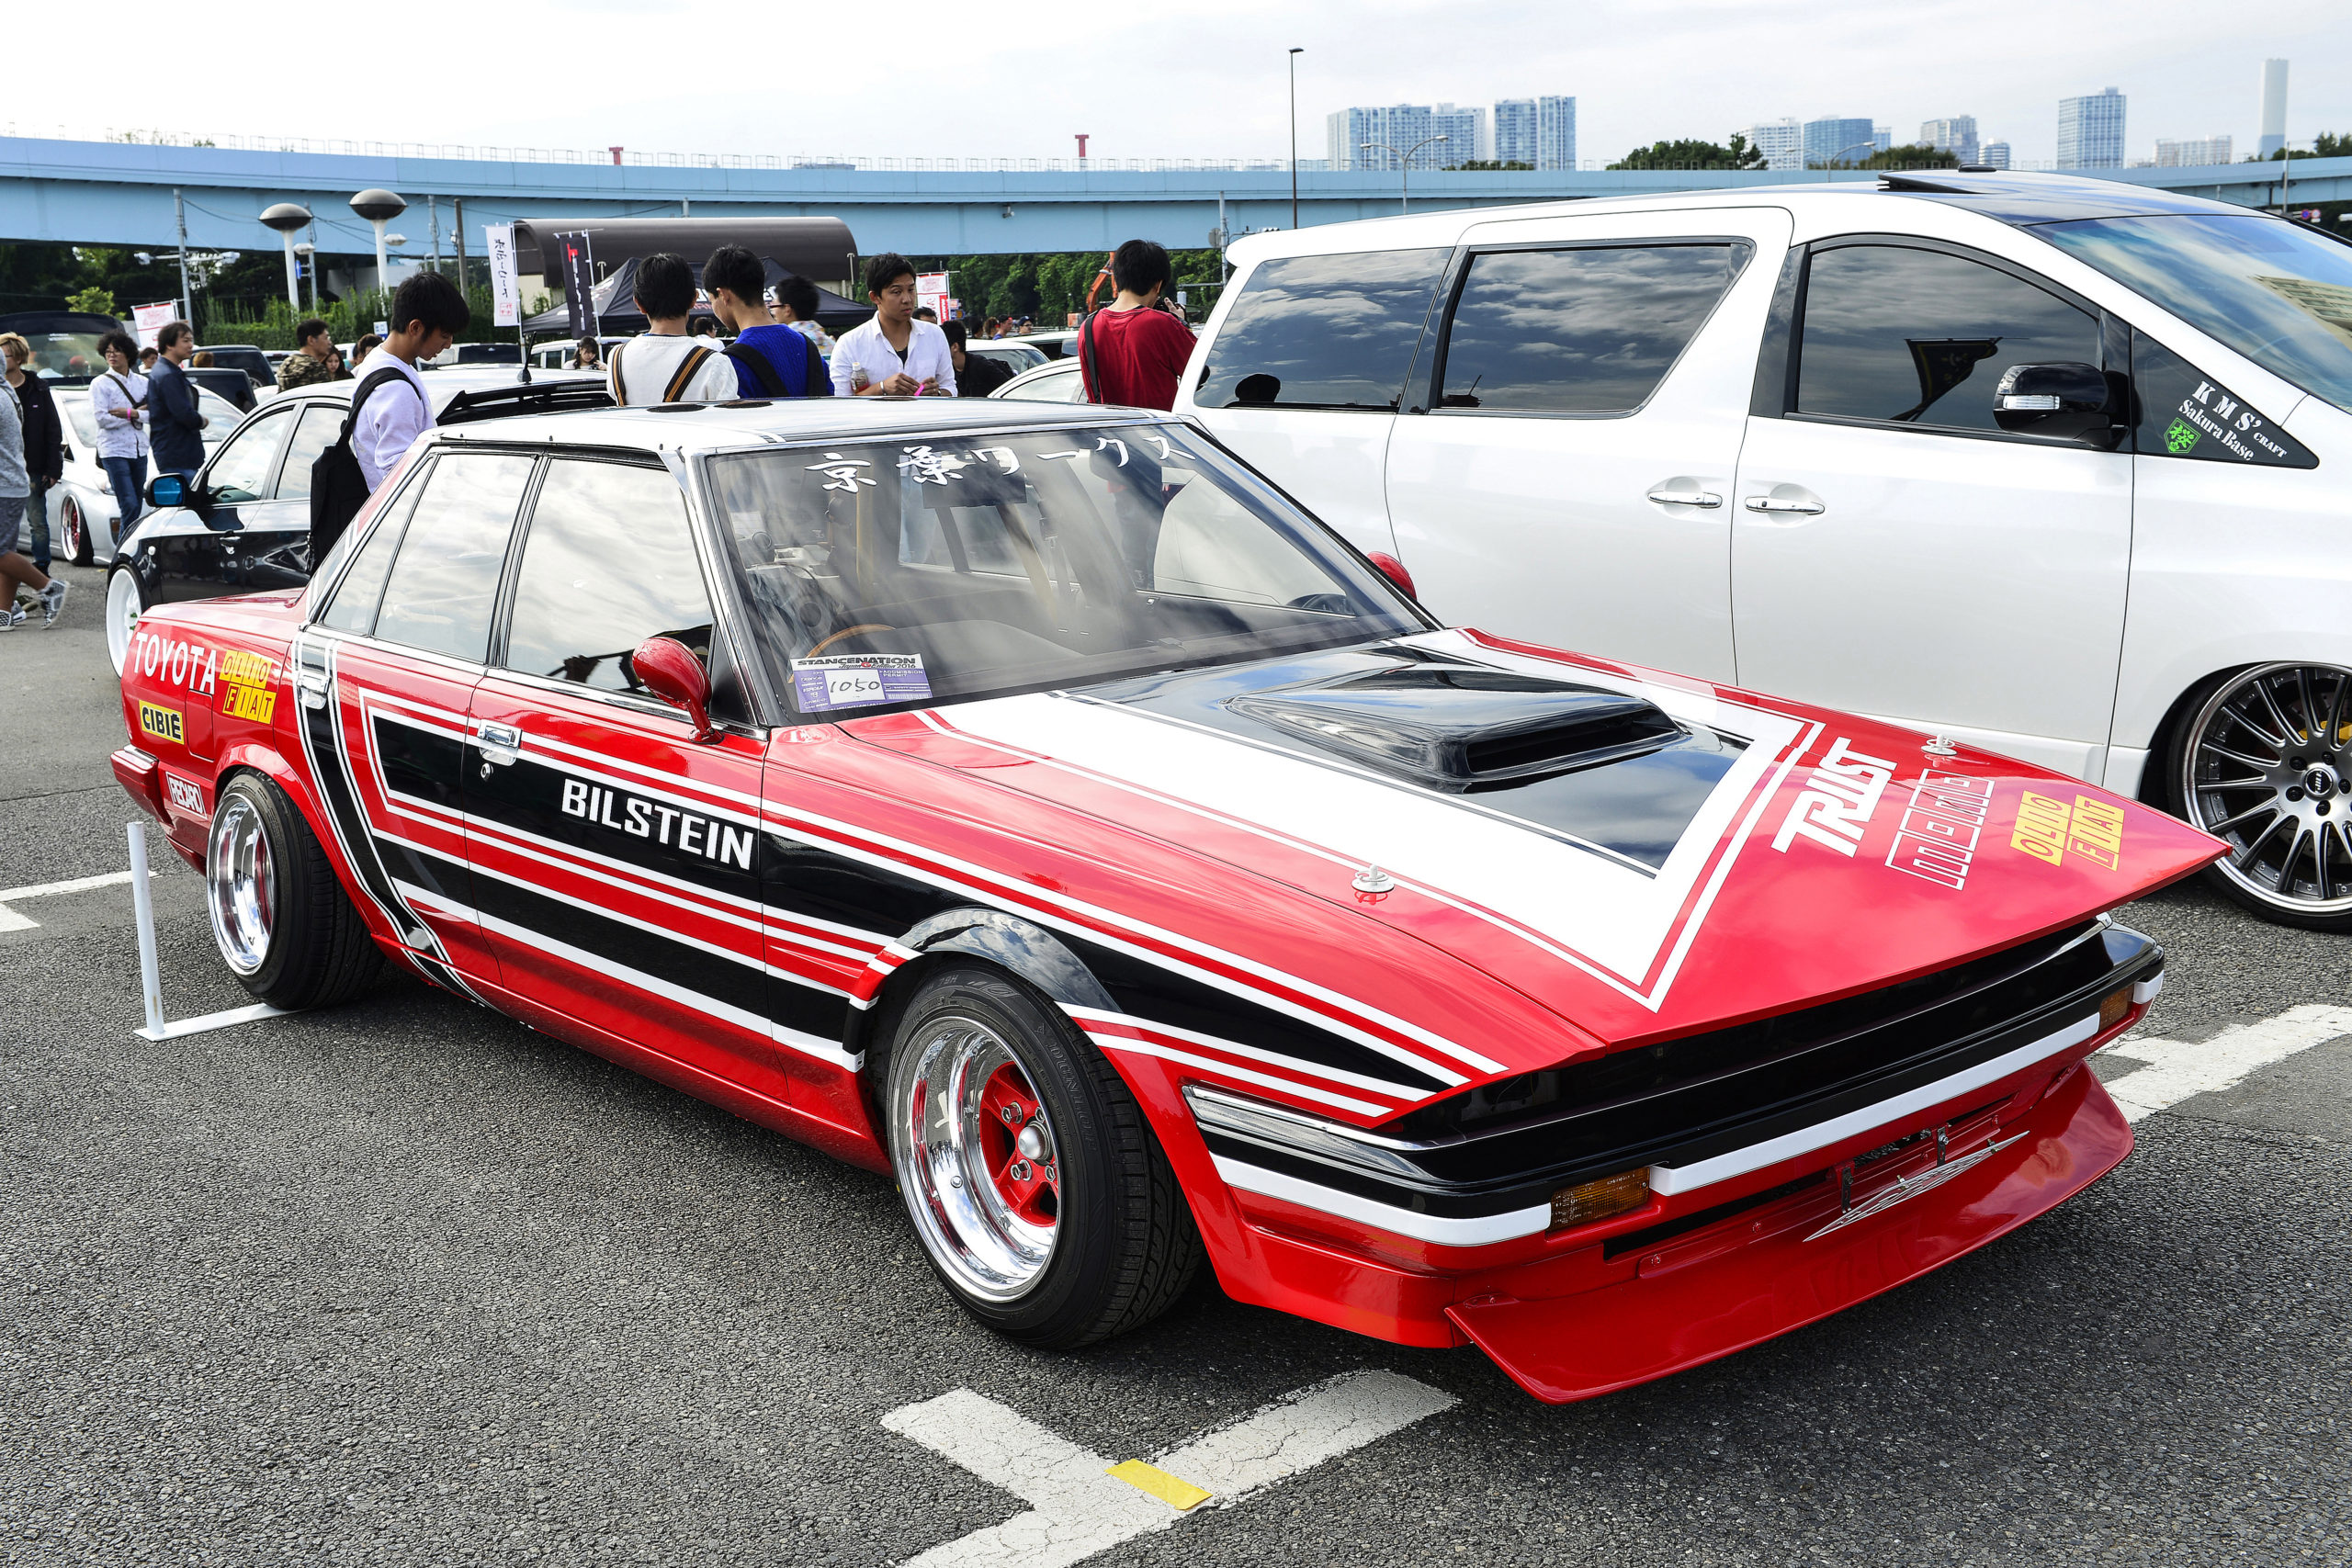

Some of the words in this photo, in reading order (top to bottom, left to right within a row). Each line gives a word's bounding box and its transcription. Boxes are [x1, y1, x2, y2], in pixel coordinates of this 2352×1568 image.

[2178, 400, 2223, 439] Sakura
[2222, 430, 2255, 460] Base
[2254, 432, 2288, 457] CRAFT
[133, 631, 217, 694] TOYOTA
[221, 651, 271, 687] OLIO
[797, 657, 916, 665] STANCENATION
[225, 685, 274, 723] FIAT
[830, 678, 881, 694] 1050
[170, 777, 203, 814] RECARO
[1770, 736, 1898, 858] TRUST
[561, 778, 754, 871] BILSTEIN
[2016, 793, 2067, 862] OLIO
[2071, 796, 2120, 866] FIAT
